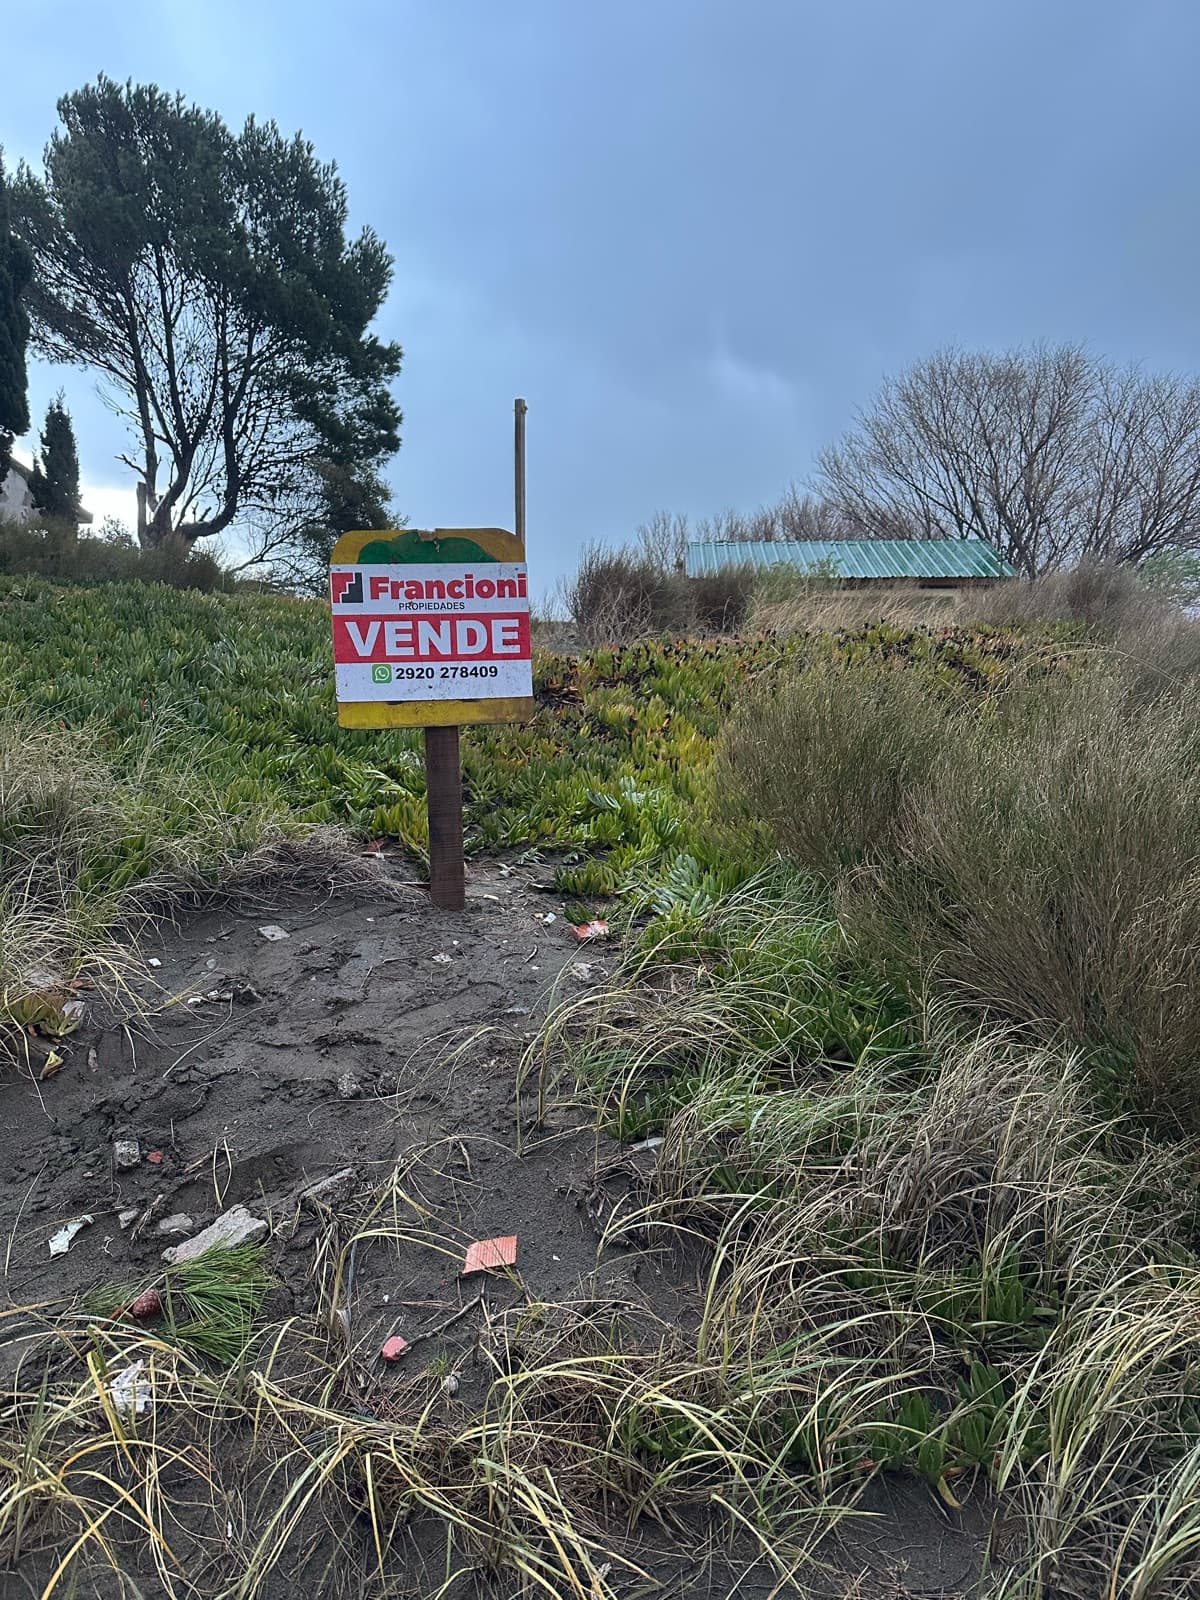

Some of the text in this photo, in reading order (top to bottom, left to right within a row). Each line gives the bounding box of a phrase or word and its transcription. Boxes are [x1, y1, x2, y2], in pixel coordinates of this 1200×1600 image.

[369, 573, 527, 600] Francioni
[398, 601, 465, 611] PROPIEDADES
[345, 618, 521, 657] VENDE
[395, 665, 498, 680] 2920 278409
